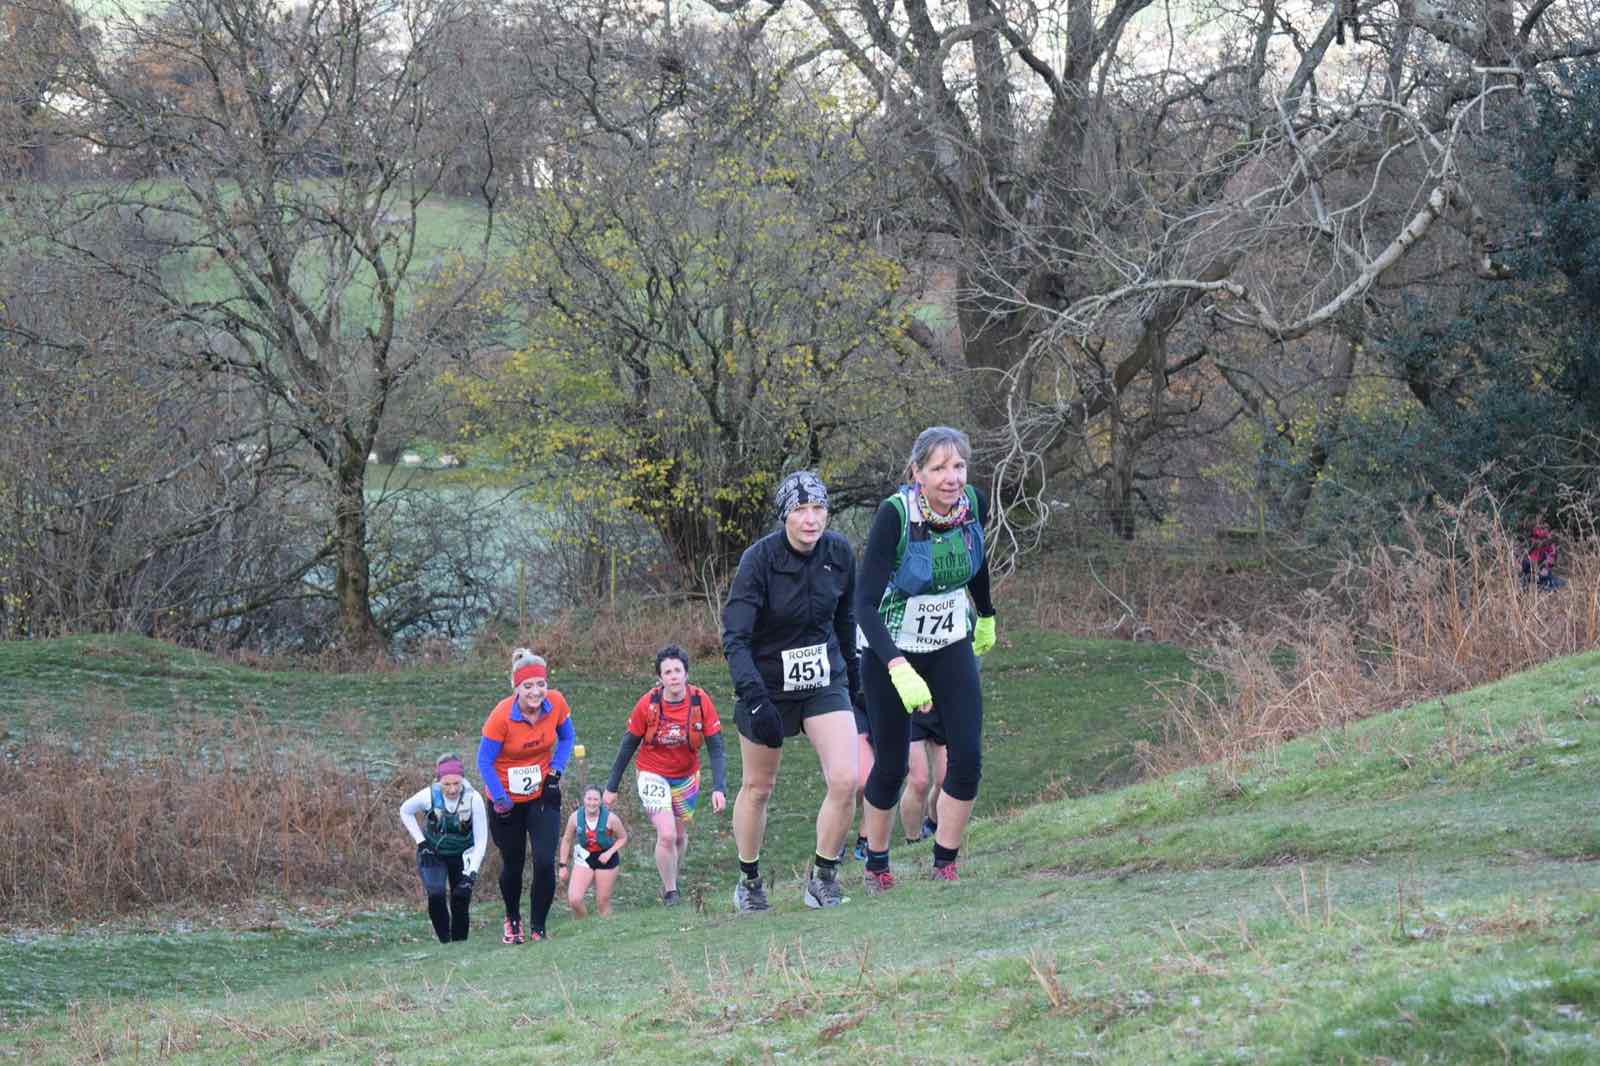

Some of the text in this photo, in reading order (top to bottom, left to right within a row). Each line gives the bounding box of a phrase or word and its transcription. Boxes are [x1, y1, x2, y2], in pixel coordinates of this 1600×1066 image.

[918, 600, 955, 613] ROGUE
[915, 610, 954, 635] 174
[916, 636, 949, 646] RUNS
[789, 646, 823, 659] ROGUE
[788, 658, 824, 682] 451
[522, 777, 534, 792] 2
[643, 784, 666, 798] 423
